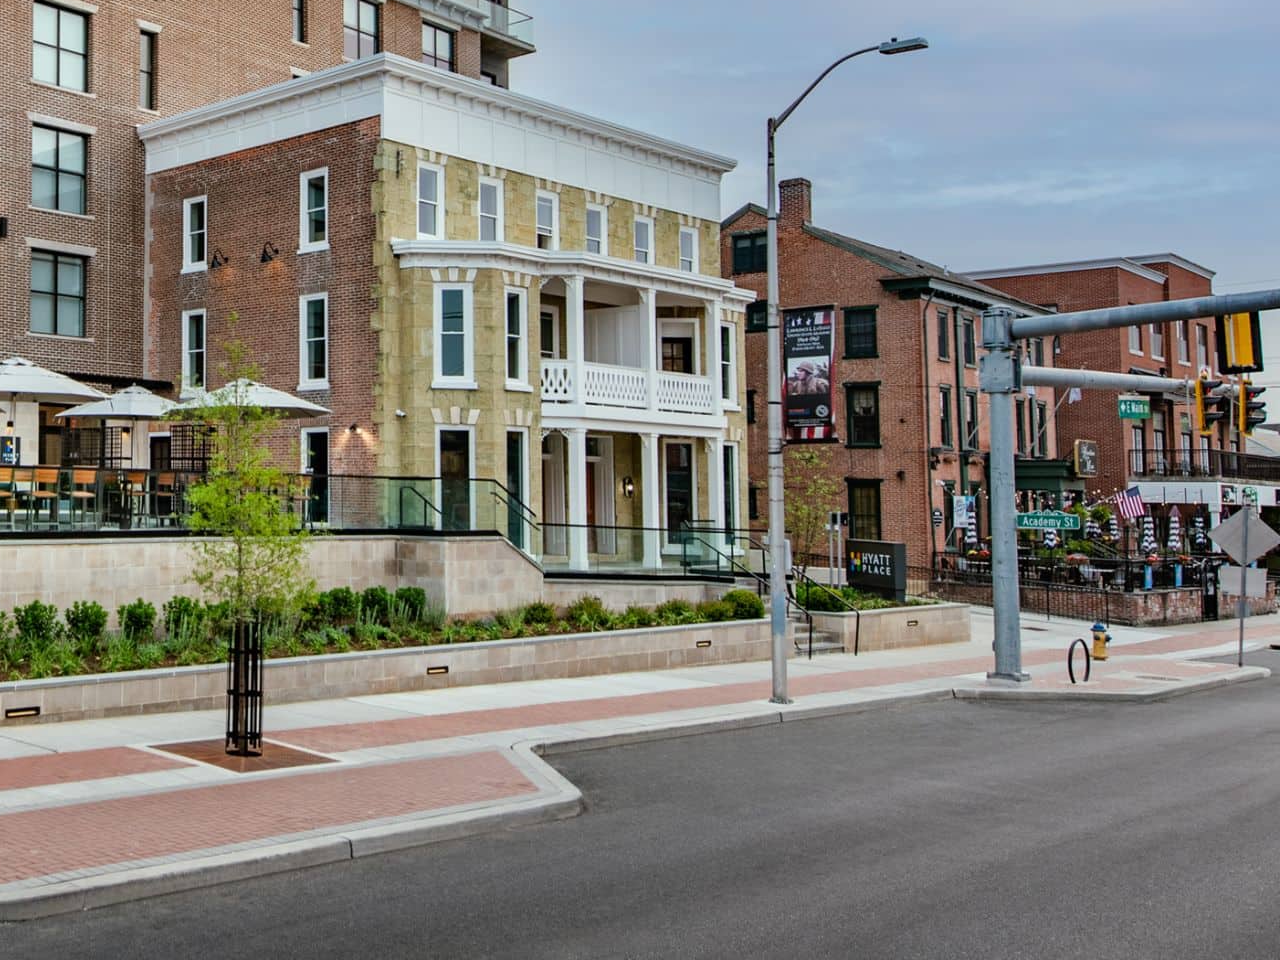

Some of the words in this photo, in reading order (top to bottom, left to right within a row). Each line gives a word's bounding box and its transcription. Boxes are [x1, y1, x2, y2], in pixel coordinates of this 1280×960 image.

[1126, 401, 1131, 413] E
[1131, 401, 1144, 413] Main
[1022, 516, 1061, 528] Academy
[1064, 517, 1074, 528] St
[862, 553, 891, 565] HYATT
[862, 564, 892, 576] PLACE
